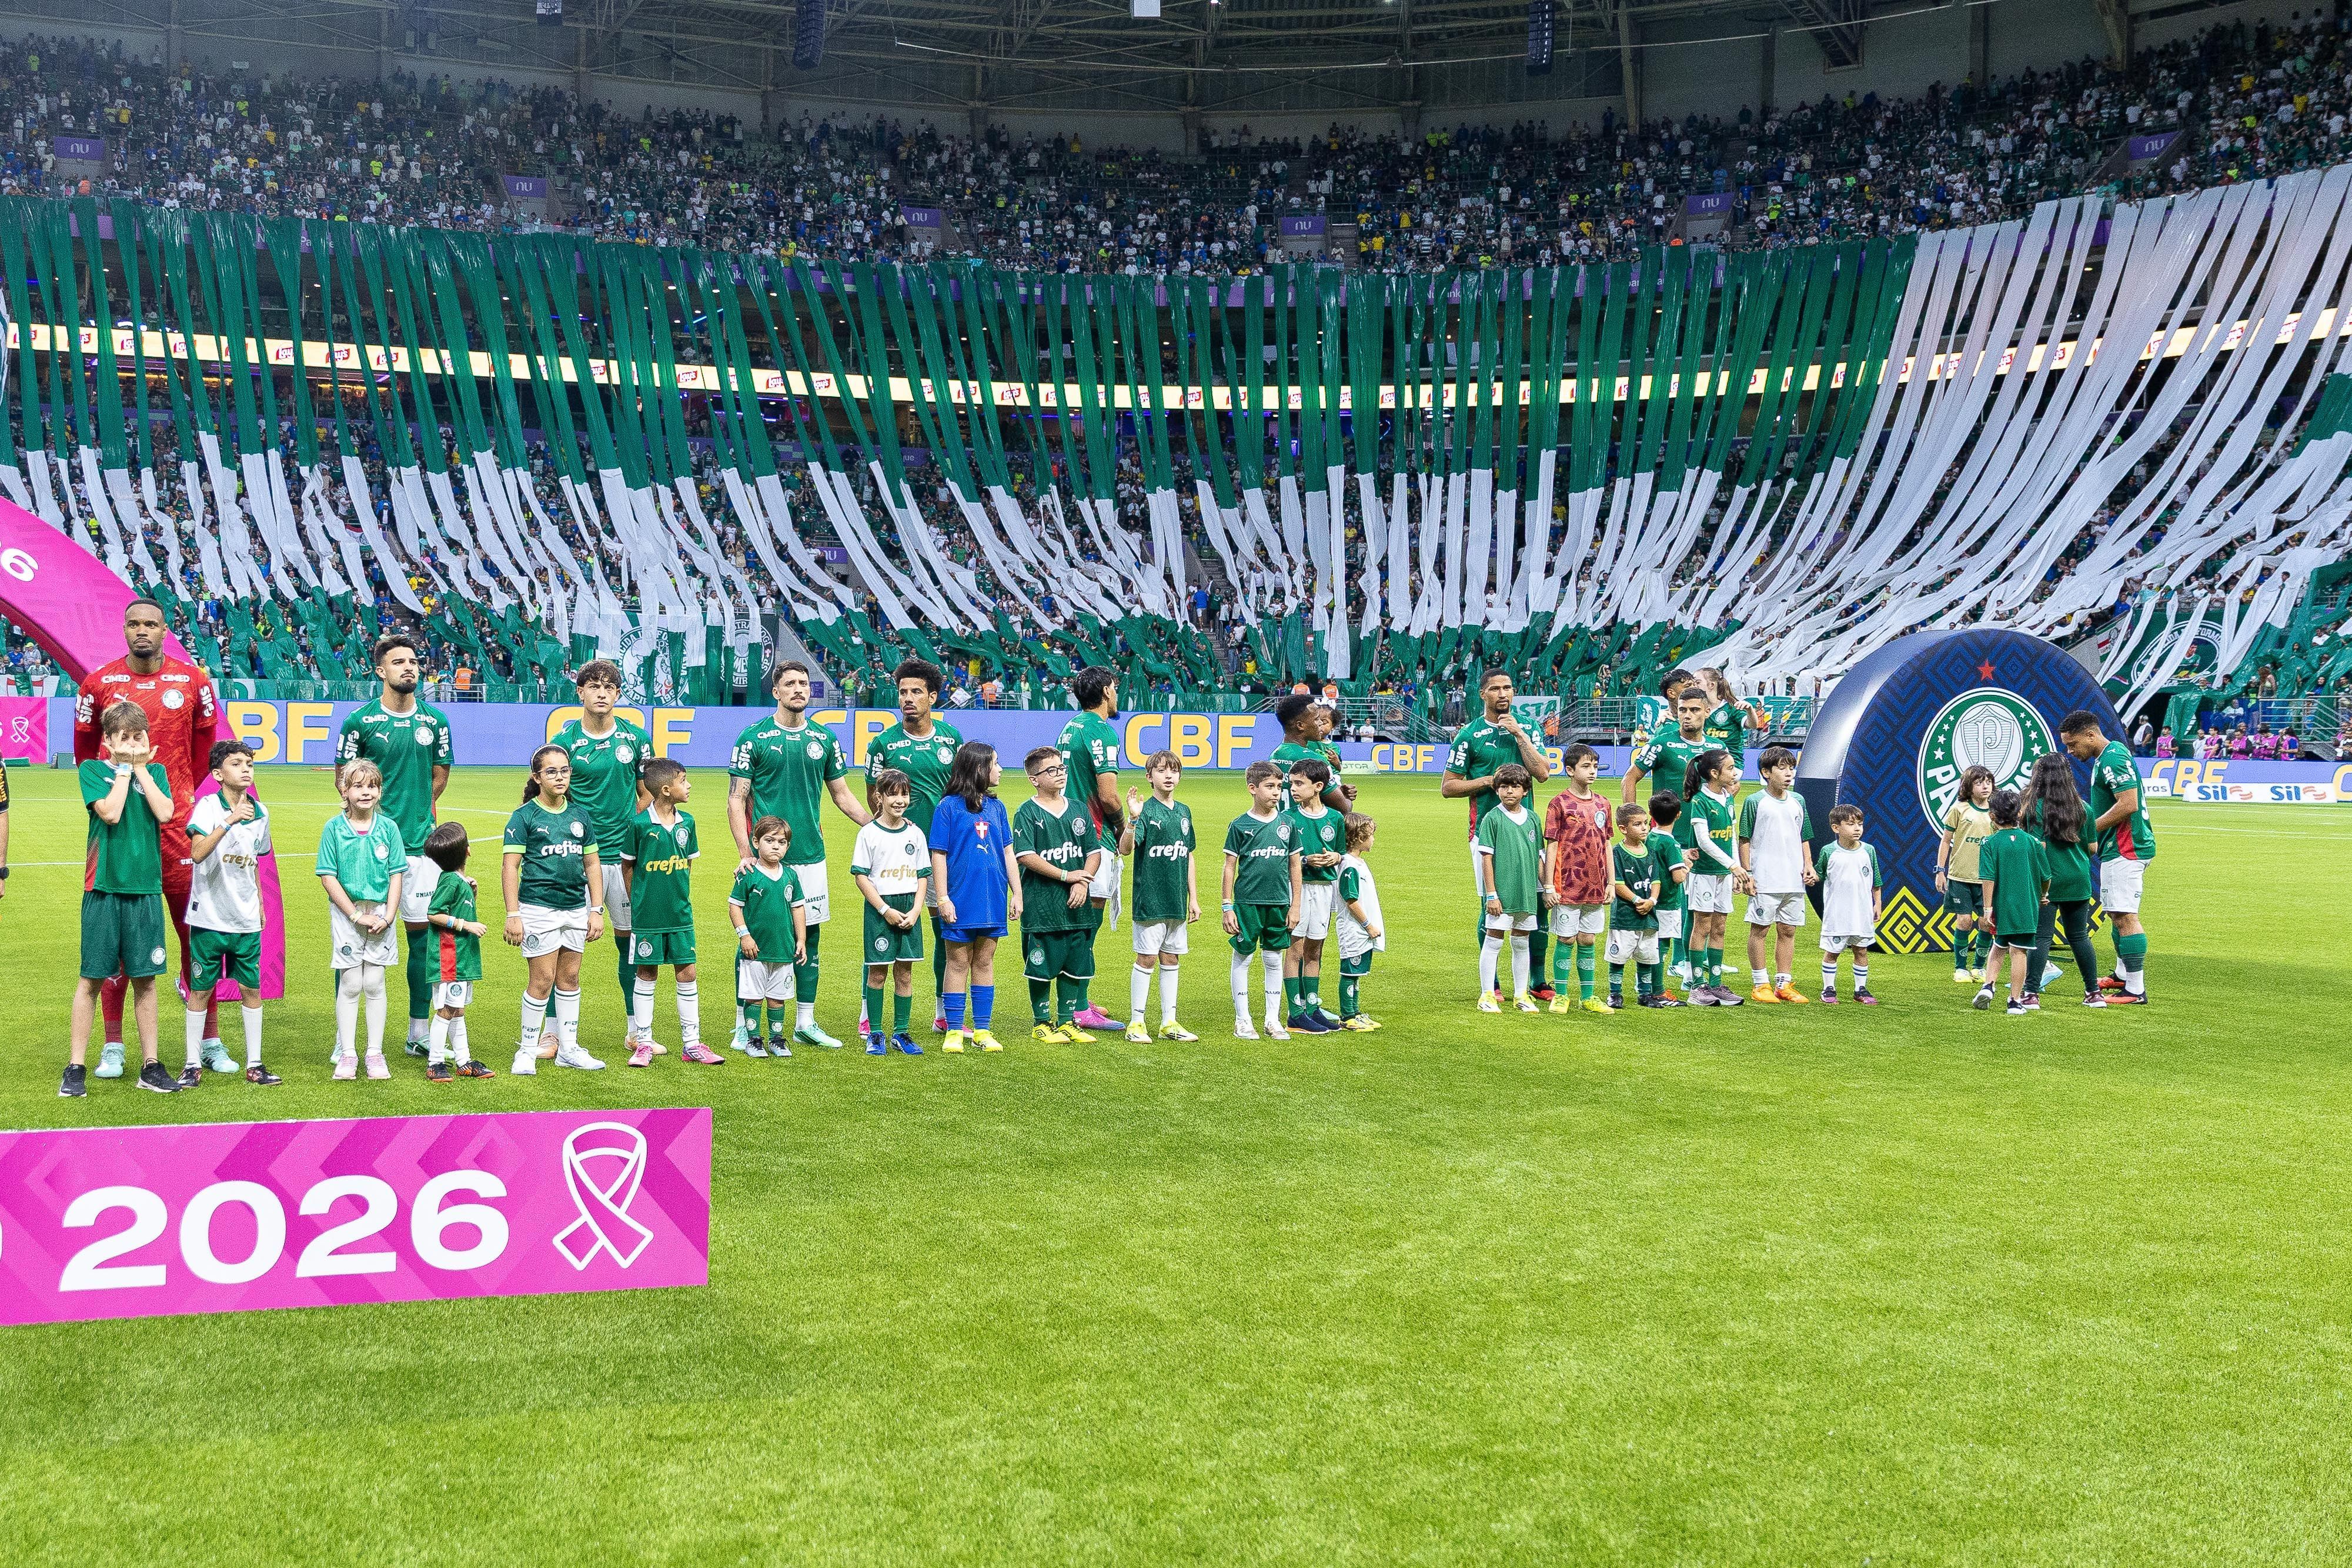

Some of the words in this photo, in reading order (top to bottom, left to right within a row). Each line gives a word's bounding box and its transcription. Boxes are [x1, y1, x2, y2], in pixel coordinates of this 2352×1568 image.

[101, 674, 132, 684] CIMED
[160, 674, 191, 684] CIMED
[614, 731, 637, 742] CIMED
[757, 730, 782, 740] CIMED
[804, 730, 827, 740] CIMED
[933, 735, 956, 745] CIMED
[887, 740, 912, 750] CIMED
[1125, 714, 1256, 768] CBF
[1371, 744, 1435, 771] CBF
[541, 840, 583, 858] crefisa
[1250, 845, 1286, 860] crefisa
[60, 1169, 510, 1292] 2026
